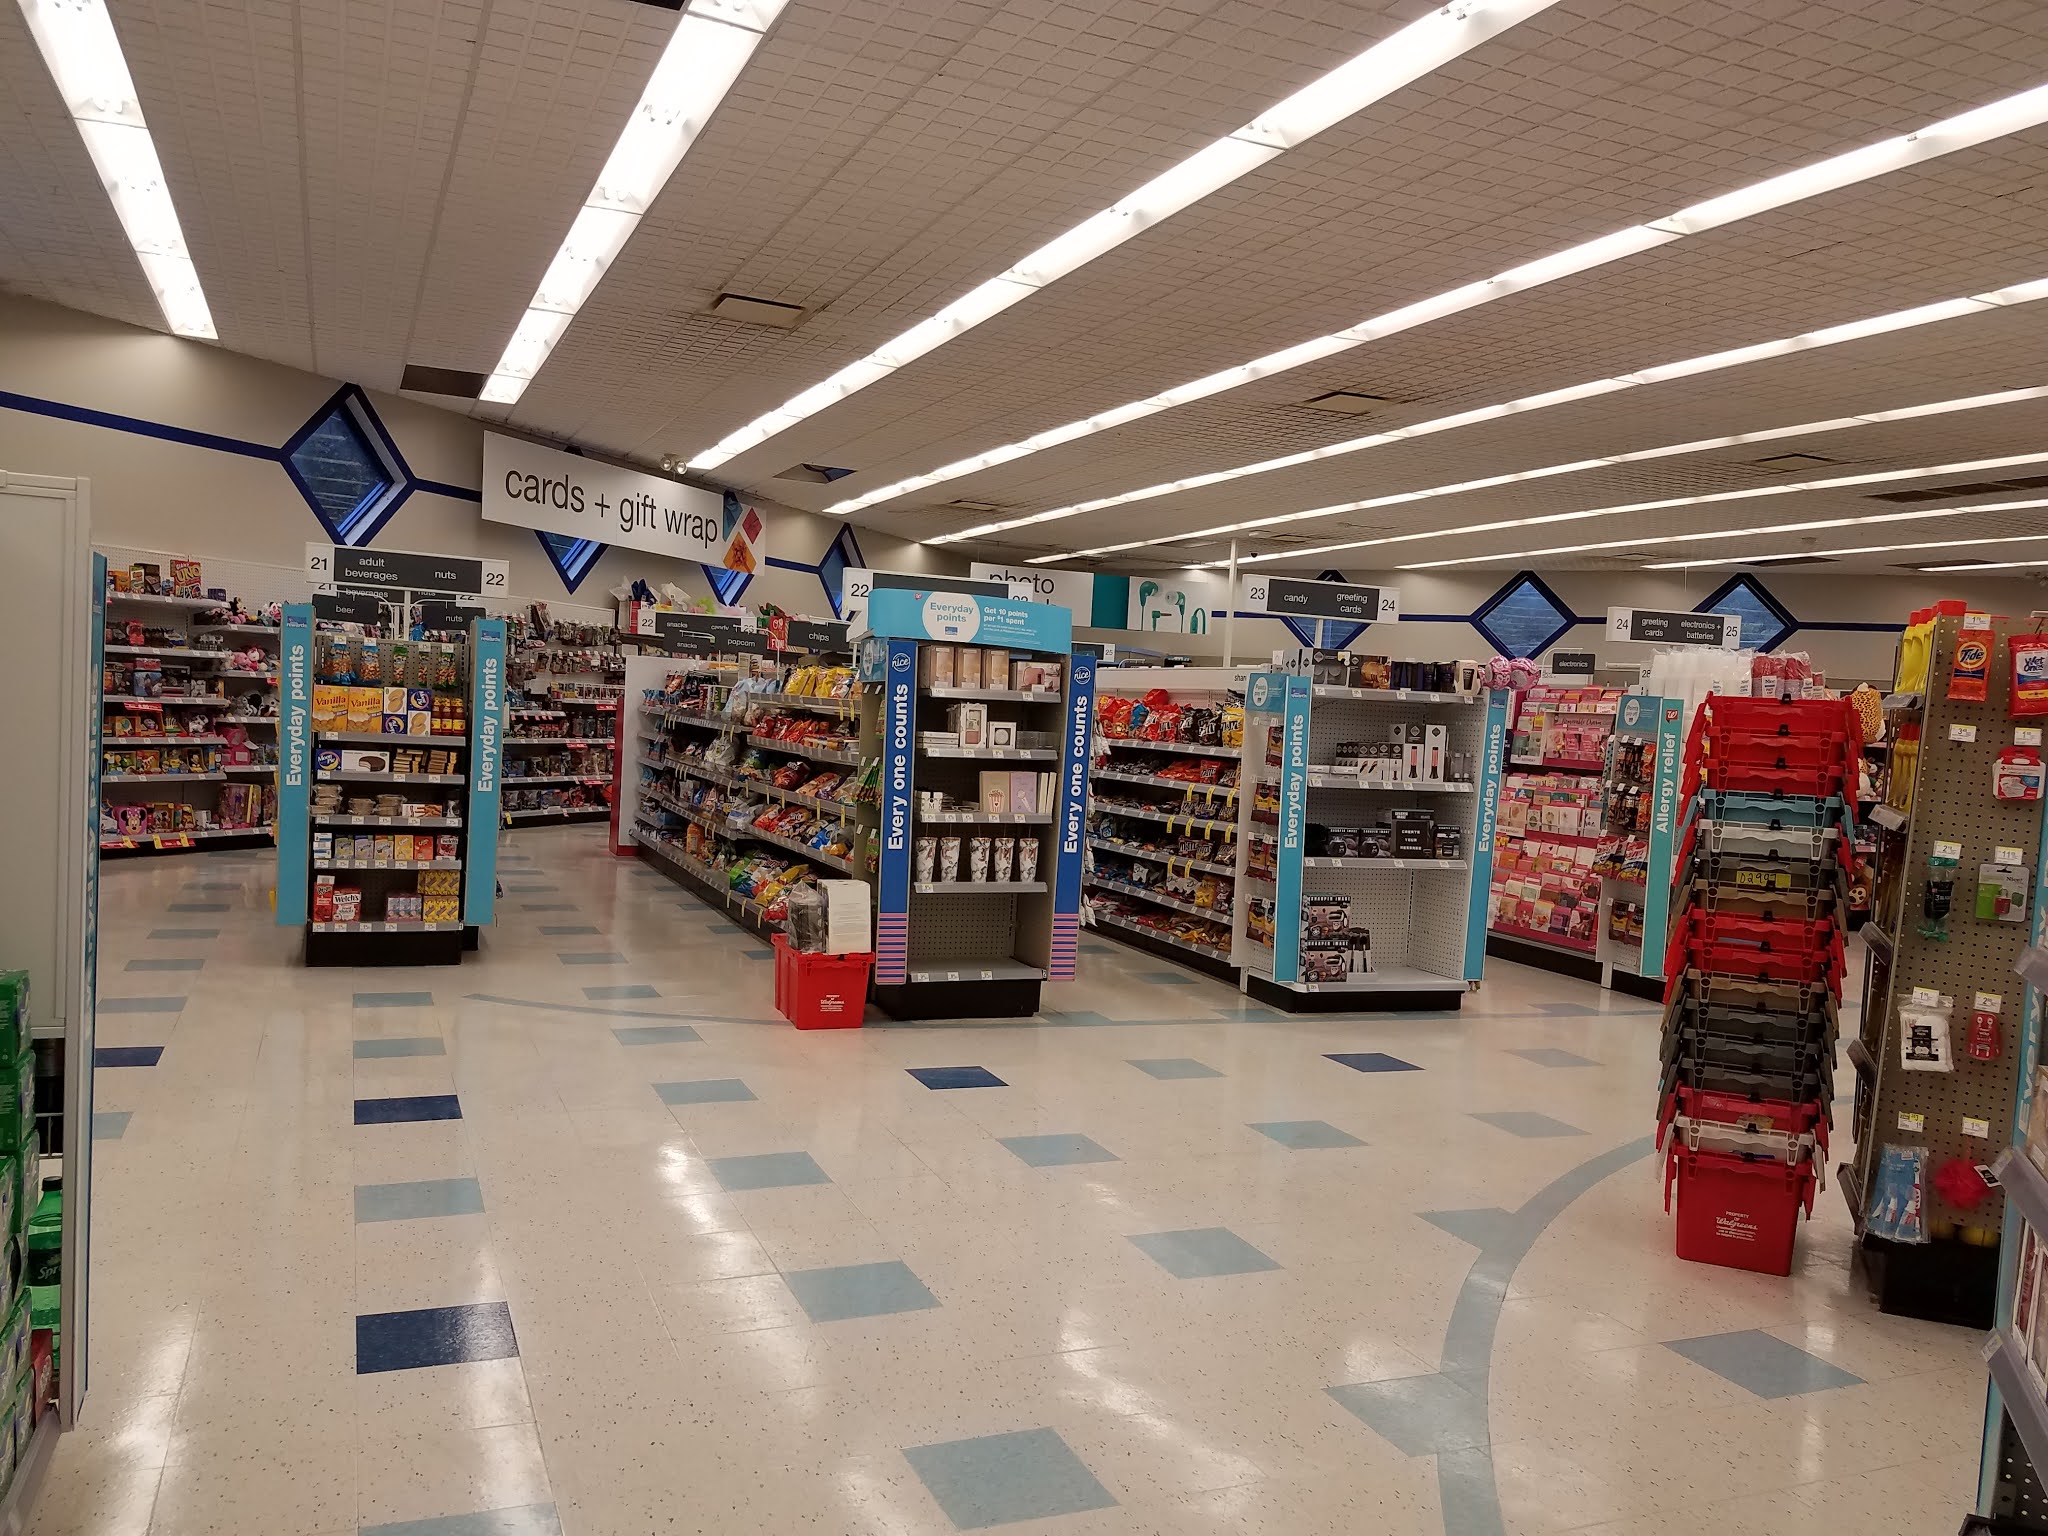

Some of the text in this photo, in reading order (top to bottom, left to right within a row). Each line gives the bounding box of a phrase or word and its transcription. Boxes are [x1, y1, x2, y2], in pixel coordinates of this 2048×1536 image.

[505, 470, 718, 549] cards + gift wrap
[310, 557, 328, 571] 21
[359, 557, 385, 568] adult
[175, 565, 201, 583] UNO
[345, 568, 398, 582] beverages
[435, 570, 457, 580] nuts
[486, 573, 505, 587] 22
[851, 583, 869, 598] 22
[1250, 587, 1266, 600] 23
[1283, 593, 1309, 605] candy
[1336, 592, 1368, 604] greeting
[335, 604, 355, 615] beer
[930, 602, 974, 615] Everyday
[1340, 605, 1362, 614] cards
[1381, 599, 1395, 612] 24
[445, 614, 463, 623] nuts
[936, 613, 967, 623] points
[983, 606, 1028, 619] Get 10 points
[641, 618, 654, 628] 22
[666, 621, 688, 629] snacks
[983, 615, 996, 623] per
[1005, 618, 1025, 627] spent
[1616, 618, 1629, 630] 24
[1641, 617, 1669, 628] greeting
[1680, 620, 1716, 630] electronics
[1644, 629, 1664, 638] cards
[1686, 631, 1714, 641] batteries
[1726, 625, 1738, 637] 25
[727, 638, 756, 648] popcorn
[808, 632, 830, 643] chips
[676, 641, 698, 650] snacks
[1959, 648, 1984, 663] Tide
[2024, 656, 2046, 666] Wet
[1558, 660, 1589, 668] electronics
[315, 696, 346, 706] Vanilla
[350, 698, 381, 708] Vanilla
[286, 645, 307, 786] Everyday points
[477, 658, 499, 793] Everyday points
[887, 683, 909, 850] Every one counts
[1064, 695, 1088, 854] Every one counts
[1284, 714, 1304, 849] Everyday points
[1655, 732, 1676, 834] Allergy relief
[1478, 724, 1501, 853] Everyday points
[334, 894, 359, 903] Welch's
[1725, 1211, 1750, 1219] PROPERTY
[1716, 1216, 1758, 1230] Walgreens
